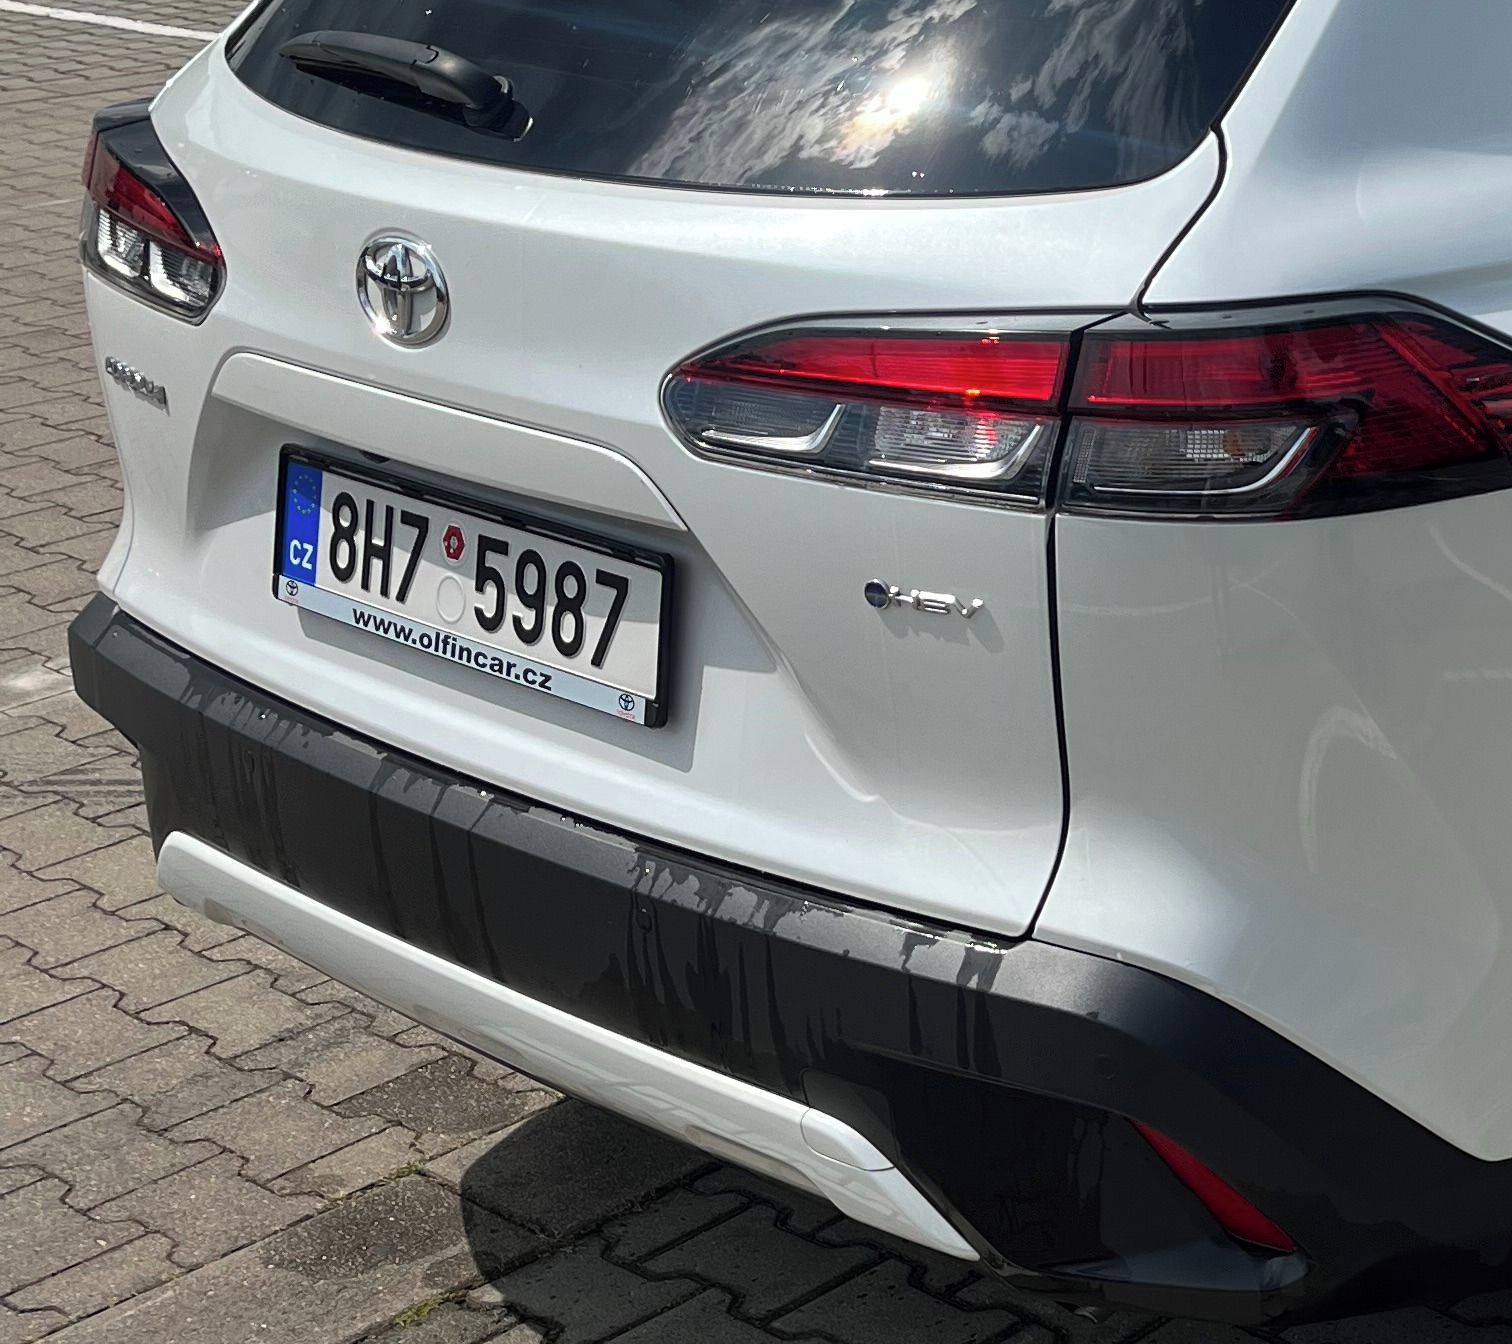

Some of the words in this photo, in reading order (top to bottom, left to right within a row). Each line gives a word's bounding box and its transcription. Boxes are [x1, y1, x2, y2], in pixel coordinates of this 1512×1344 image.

[288, 538, 314, 571] CZ
[329, 491, 430, 605] 8H7
[473, 534, 630, 670] 5987
[351, 607, 553, 692] www.olfincar.cz
